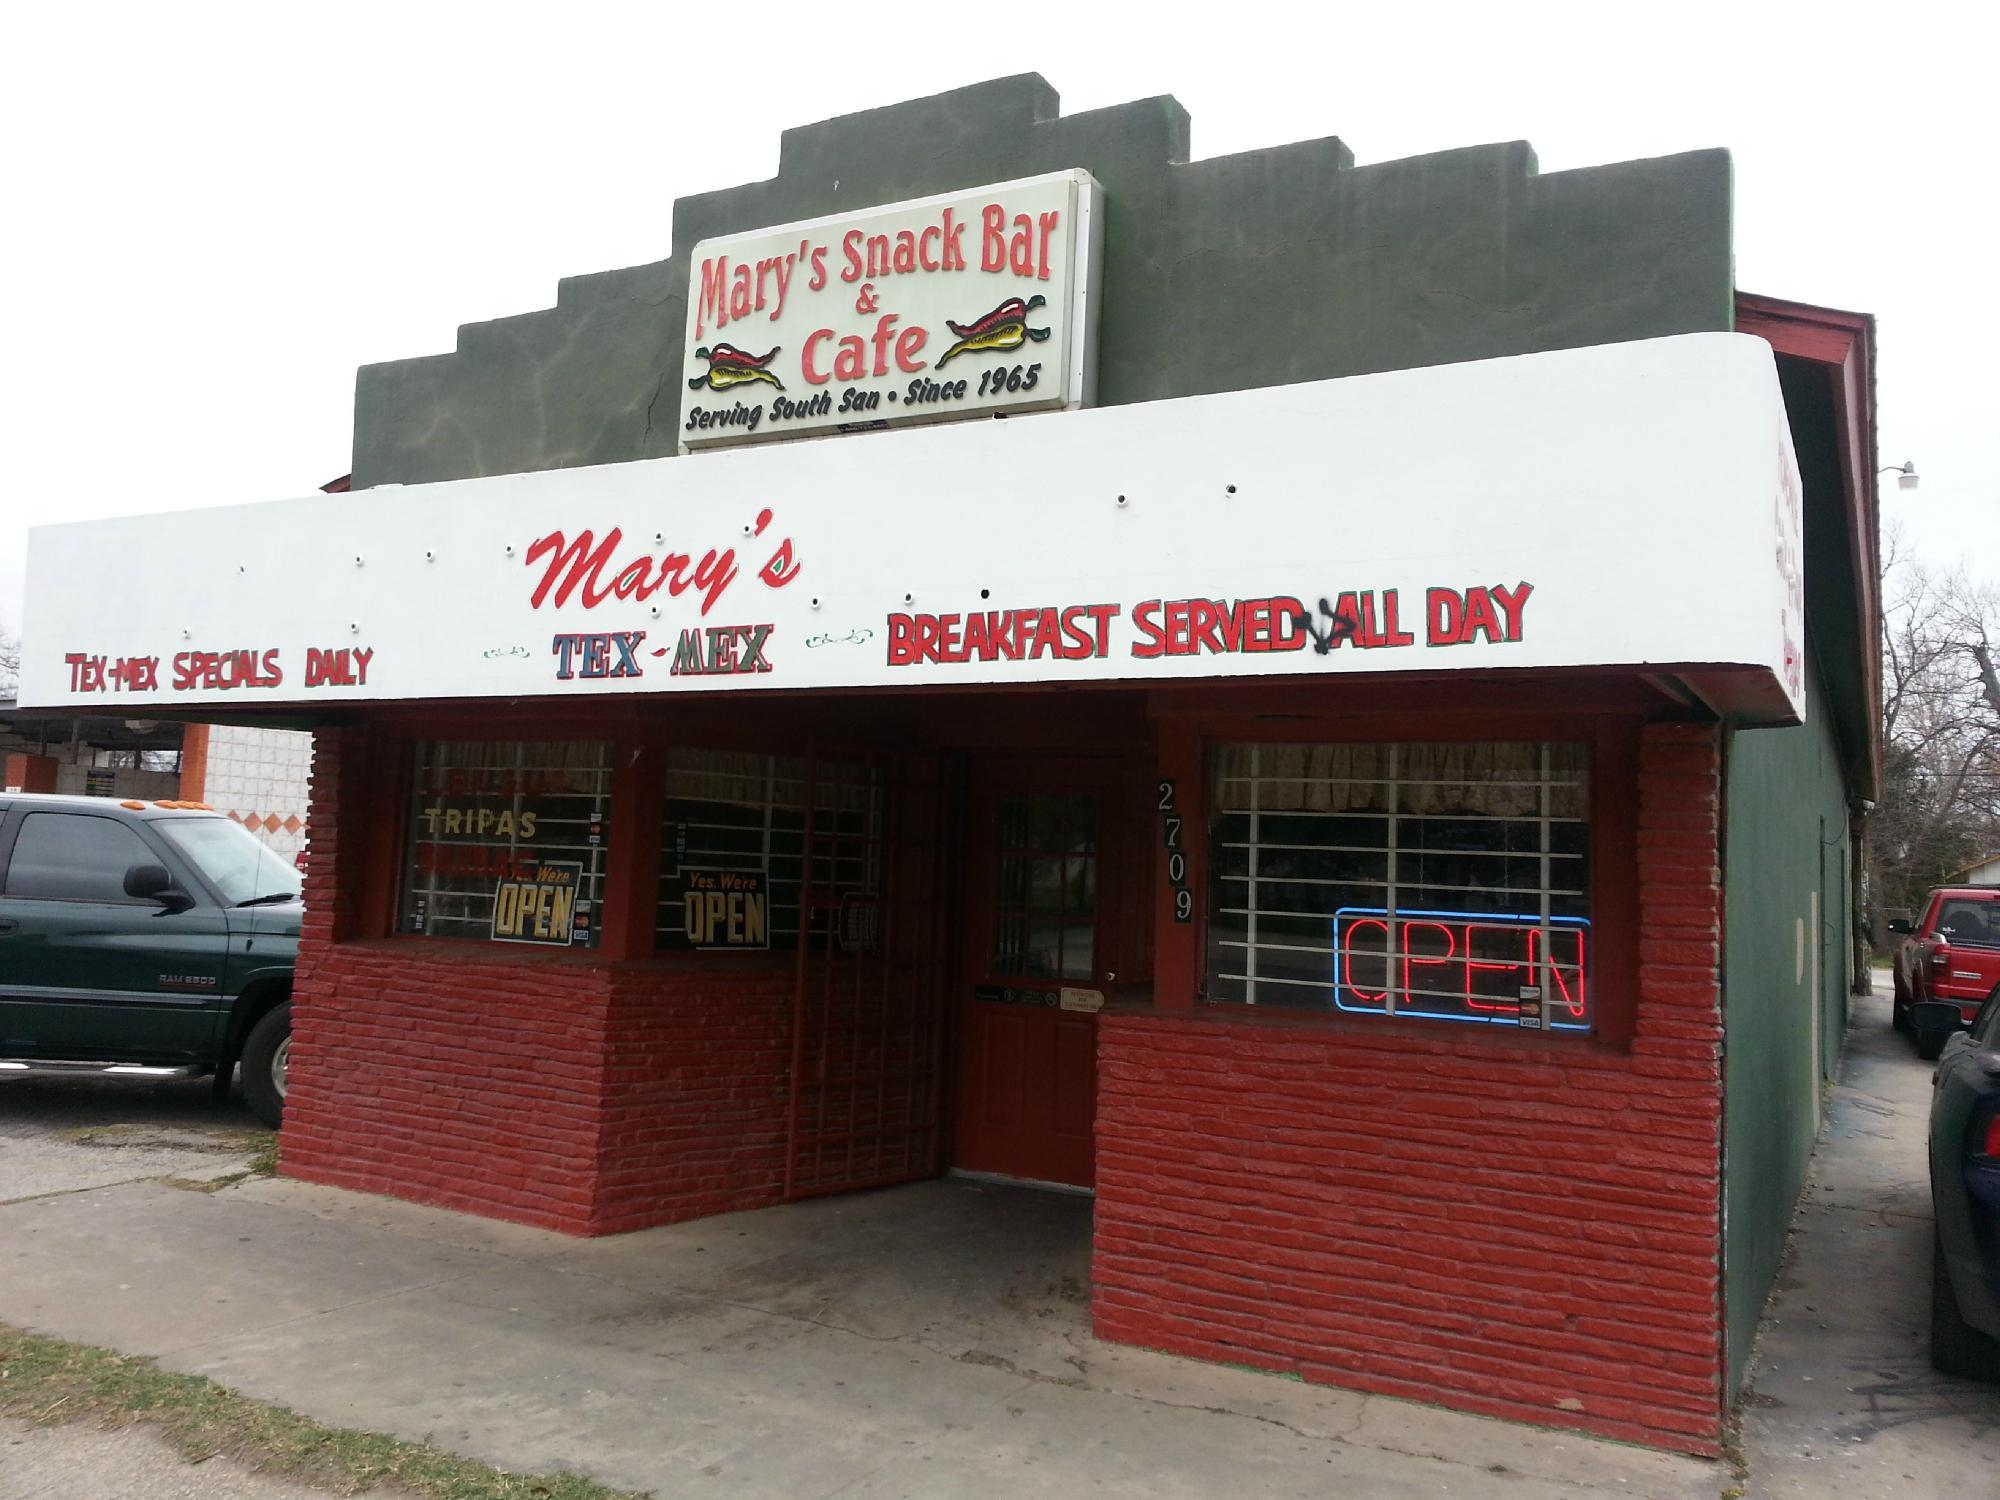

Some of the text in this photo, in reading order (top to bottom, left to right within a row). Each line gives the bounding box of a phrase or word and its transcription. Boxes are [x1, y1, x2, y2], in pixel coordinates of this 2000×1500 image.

[695, 203, 1058, 341] Mary's Snack Bar
[856, 283, 879, 313] &
[801, 313, 929, 385] Cafe
[686, 363, 1042, 431] Serving South San Since 1965
[525, 507, 801, 616] Mary's
[887, 580, 1534, 666] BREAKFAST SERVED ALL DAY
[65, 646, 374, 693] TEX-MEX SPECIALS DAILY
[424, 808, 537, 838] TRIPAS
[496, 883, 574, 939] OPEN
[684, 891, 765, 944] OPEN
[1346, 919, 1585, 1016] OPEN
